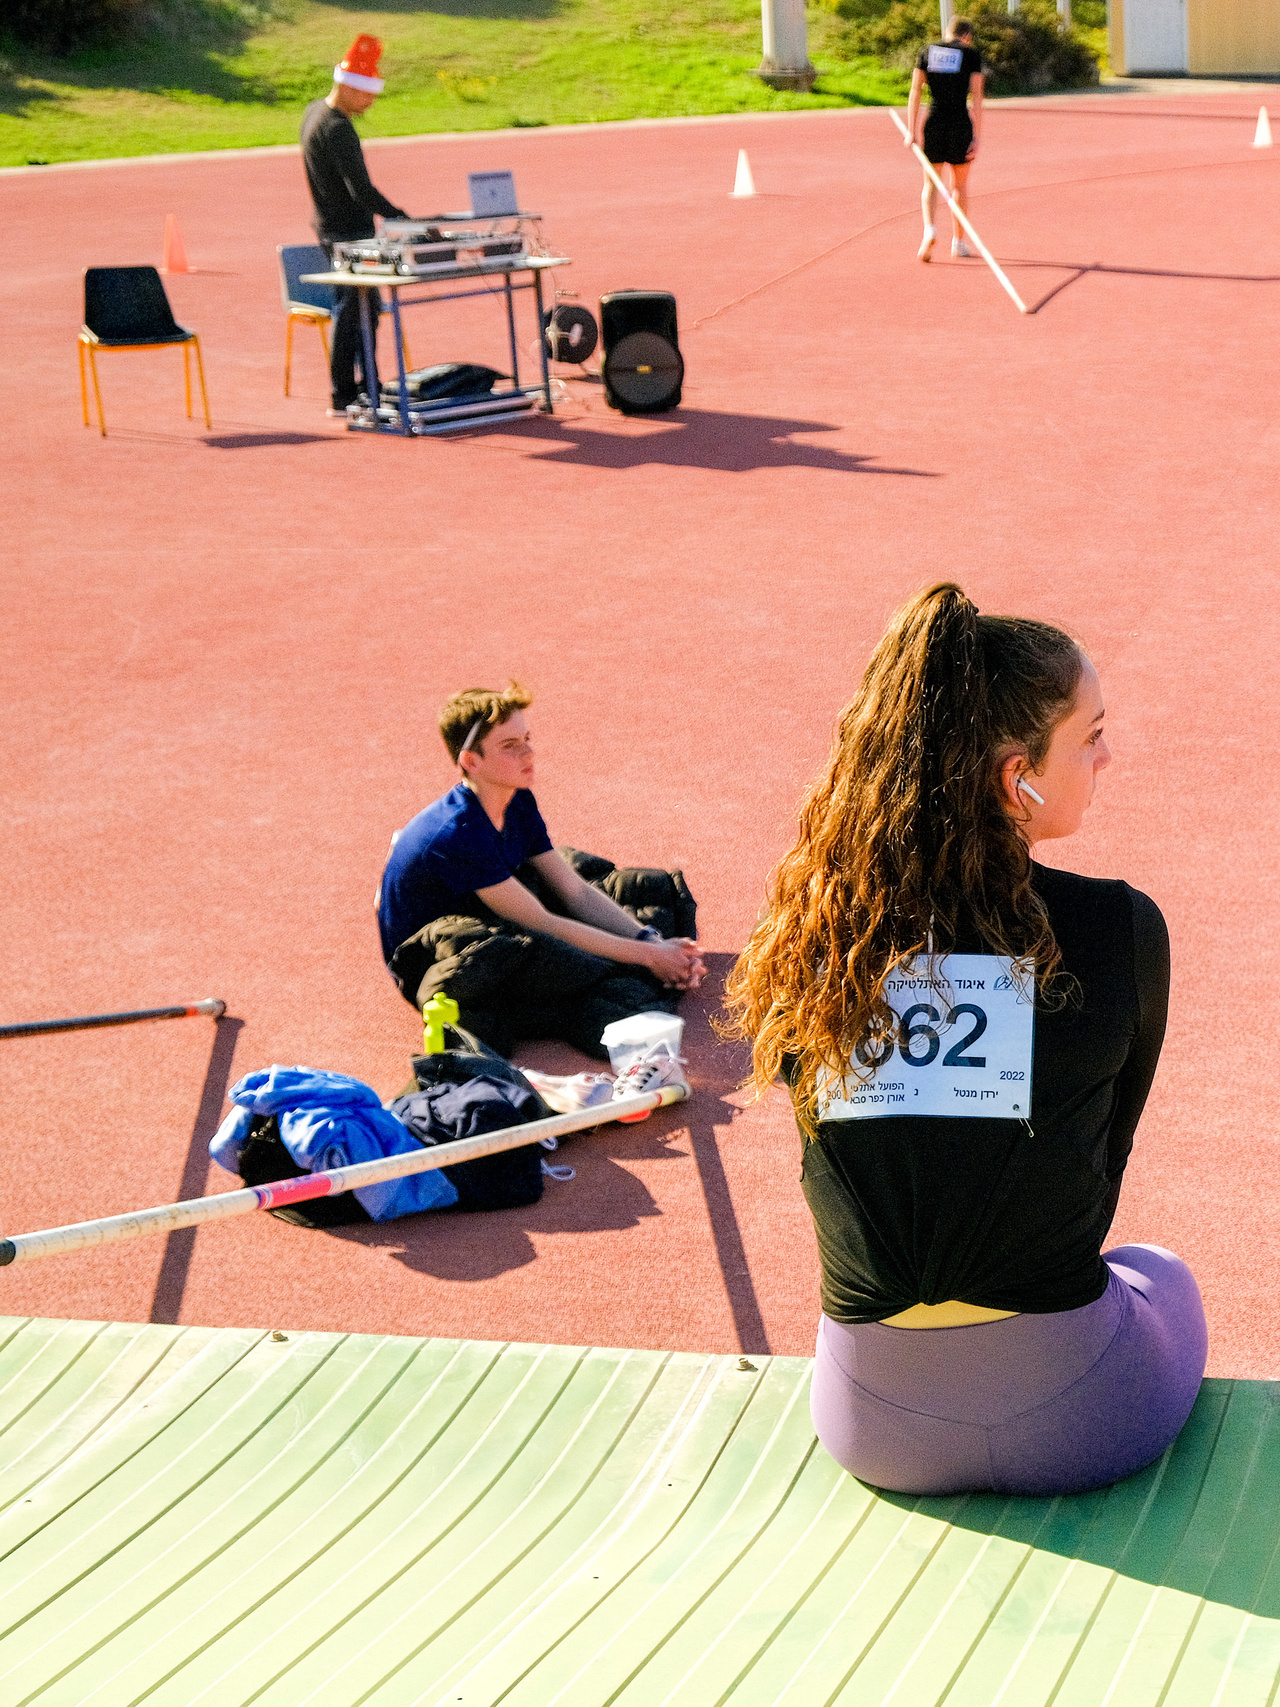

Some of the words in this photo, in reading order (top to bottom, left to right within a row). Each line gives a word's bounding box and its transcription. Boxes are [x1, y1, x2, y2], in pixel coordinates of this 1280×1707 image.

[954, 978, 986, 990] איגוד
[999, 1070, 1025, 1081] 2022
[877, 1081, 905, 1091] הפועל
[953, 1087, 977, 1098] מנטל
[980, 1090, 999, 1100] ירדן
[868, 1095, 884, 1103] כפר
[887, 1094, 905, 1104] אורן
